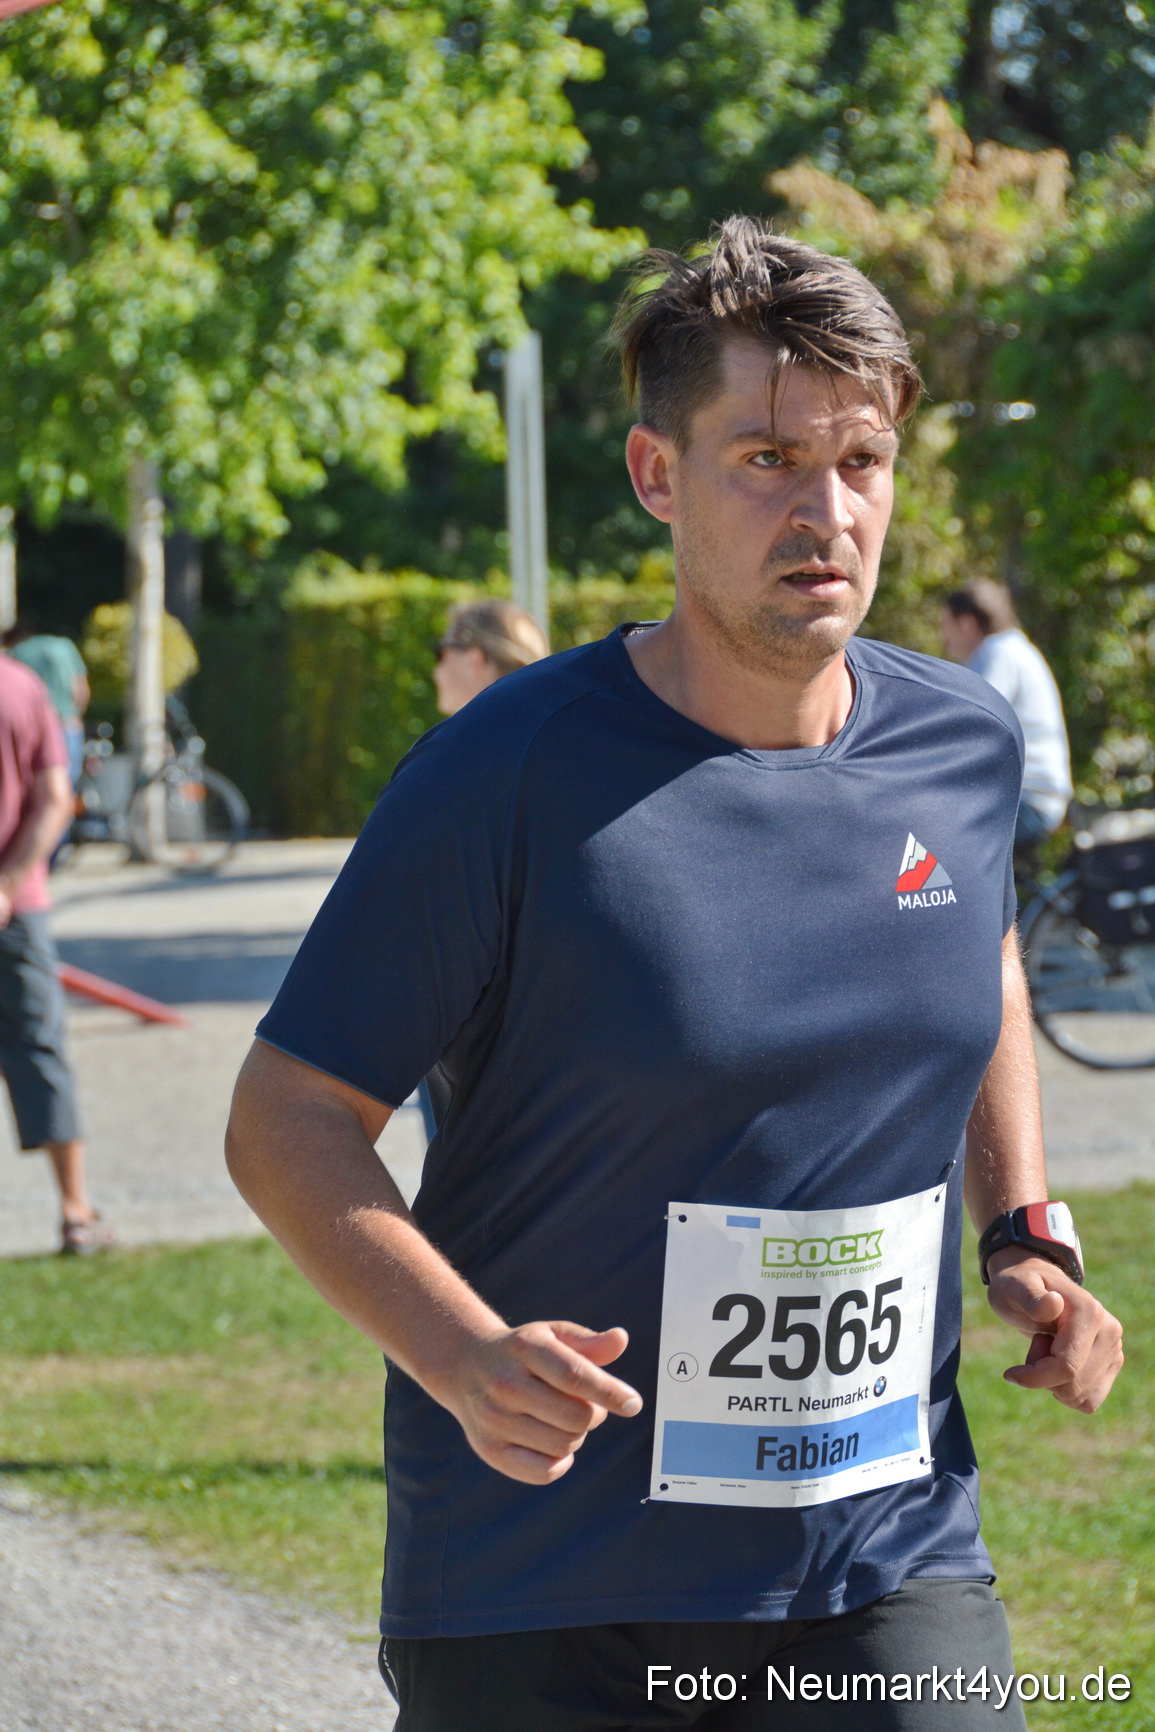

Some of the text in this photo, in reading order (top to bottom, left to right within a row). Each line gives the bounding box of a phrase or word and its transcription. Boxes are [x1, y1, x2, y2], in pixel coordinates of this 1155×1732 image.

[897, 888, 957, 911] MALOJA
[763, 1231, 882, 1267] BOCK
[760, 1259, 882, 1280] inspired by smart concepts
[708, 1276, 903, 1381] 2565
[676, 1360, 688, 1375] A
[727, 1395, 793, 1412] PARTL
[798, 1385, 869, 1412] Neumarkt
[756, 1432, 859, 1472] Fabian
